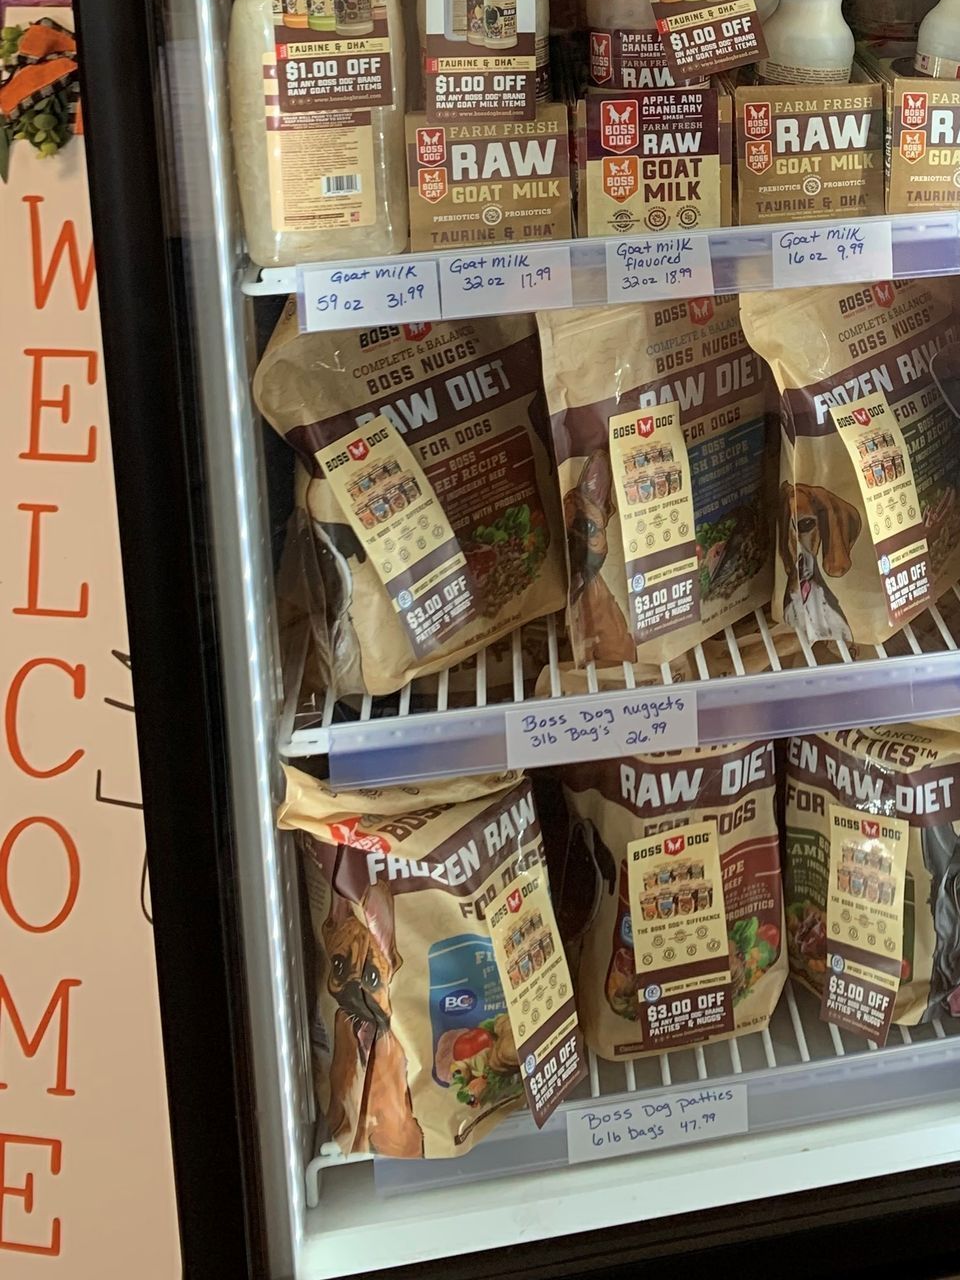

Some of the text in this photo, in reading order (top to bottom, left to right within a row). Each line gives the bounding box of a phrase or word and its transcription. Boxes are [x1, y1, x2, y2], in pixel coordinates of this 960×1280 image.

[493, 74, 527, 91] OFF
[450, 121, 559, 138] FARM FRESH
[775, 113, 872, 154] RAW
[643, 131, 703, 154] RAW
[452, 139, 557, 181] RAW
[643, 158, 703, 180] GOAT
[452, 180, 561, 204] GOAT MILK
[643, 180, 702, 203] MILK
[616, 238, 694, 258] Goat milk
[779, 226, 866, 250] Goat milk
[449, 254, 531, 274] Goat milk
[625, 252, 682, 271] flavored
[788, 241, 864, 265] 16 oz 9.99
[330, 265, 419, 283] Goat milk
[461, 266, 552, 291] 32 oz 17.99
[621, 267, 693, 290] 32 oz 18.99
[316, 284, 426, 312] 59 oz 31.99
[0, 195, 98, 1258] WELCOME
[522, 696, 685, 733] Boss Dog nuggets
[563, 723, 611, 742] Bag's
[625, 721, 668, 745] 26.99
[620, 763, 703, 809] RAW
[825, 754, 955, 816] RAW DIET
[483, 791, 537, 858] RAW
[581, 1108, 634, 1131] Boss
[642, 1102, 673, 1119] Dog
